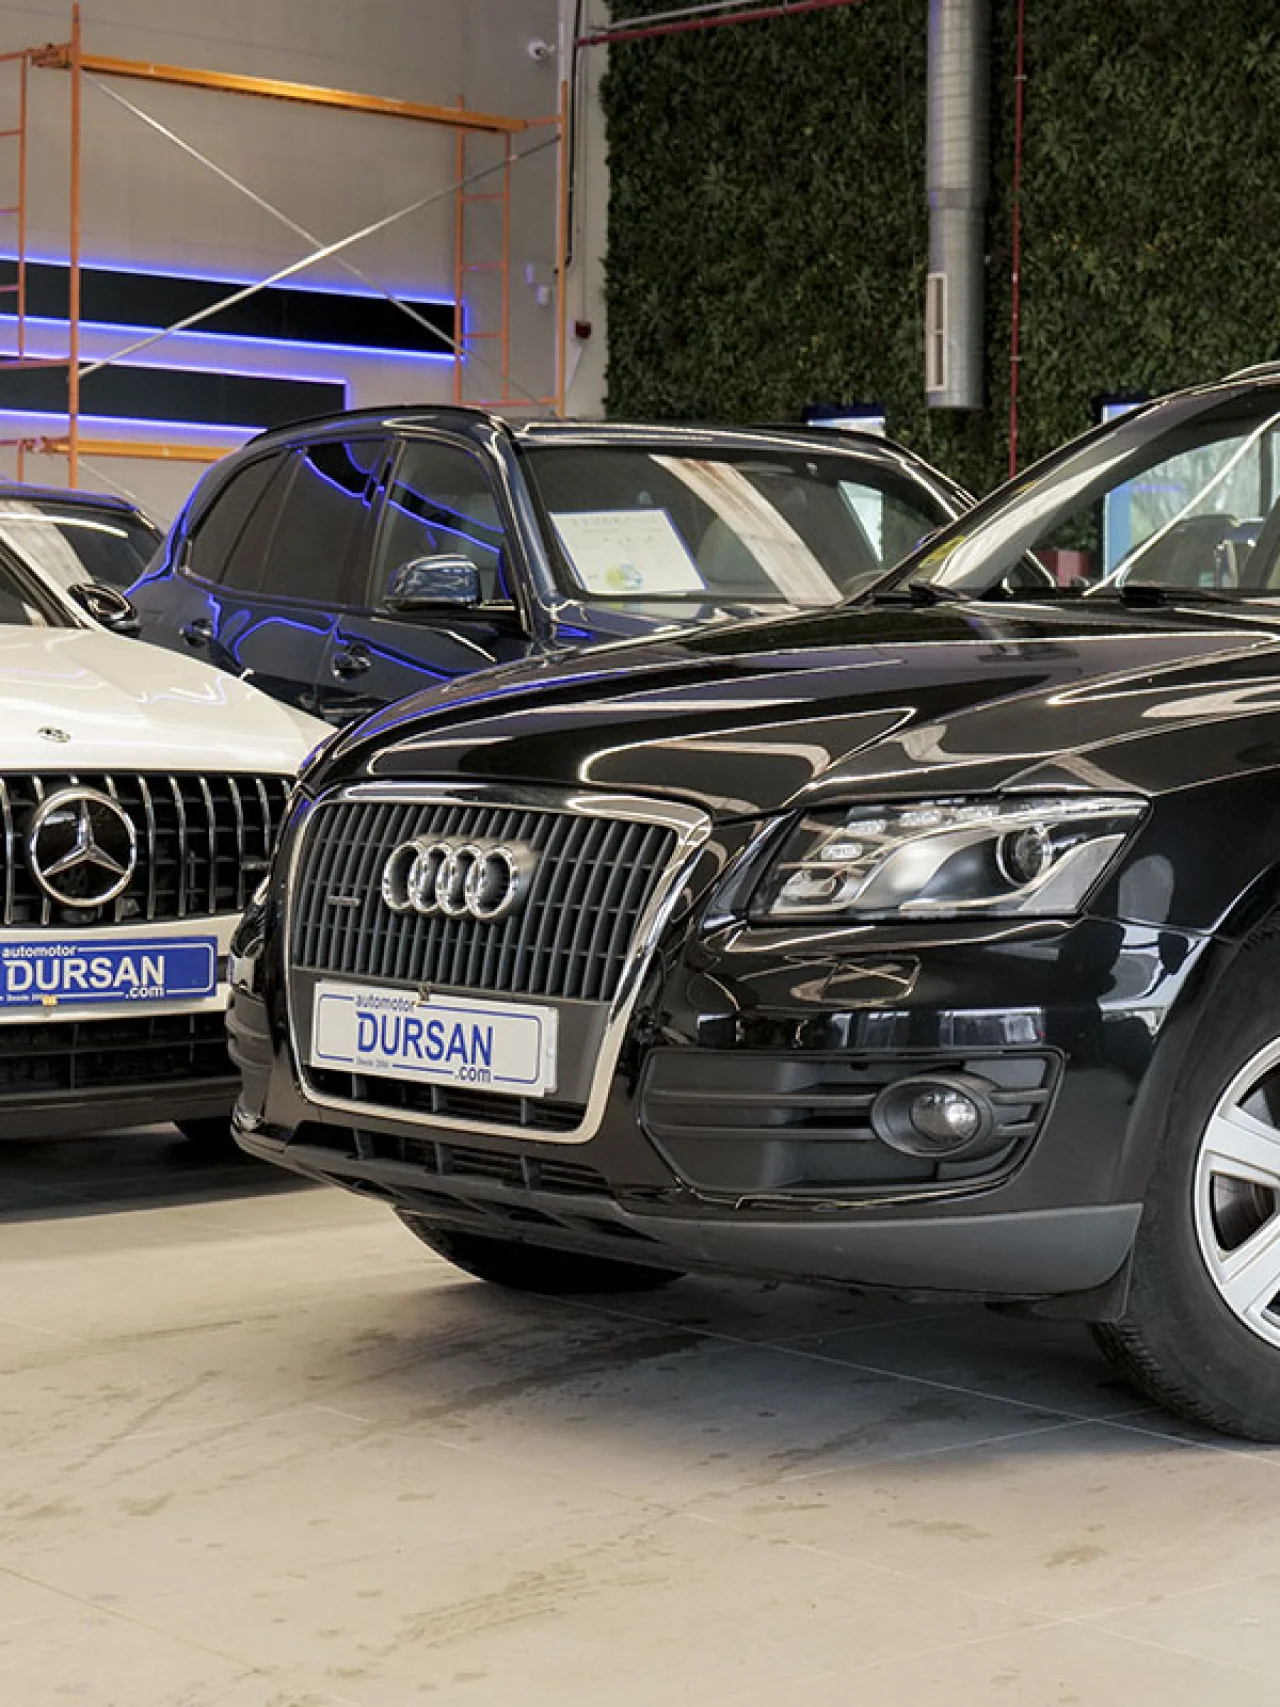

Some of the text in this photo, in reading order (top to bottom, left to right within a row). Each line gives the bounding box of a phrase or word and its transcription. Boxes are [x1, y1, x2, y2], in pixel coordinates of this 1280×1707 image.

[3, 956, 165, 991] DURSAN
[125, 987, 164, 999] .com
[356, 1012, 493, 1066] DURSAN
[454, 1066, 491, 1083] .com
